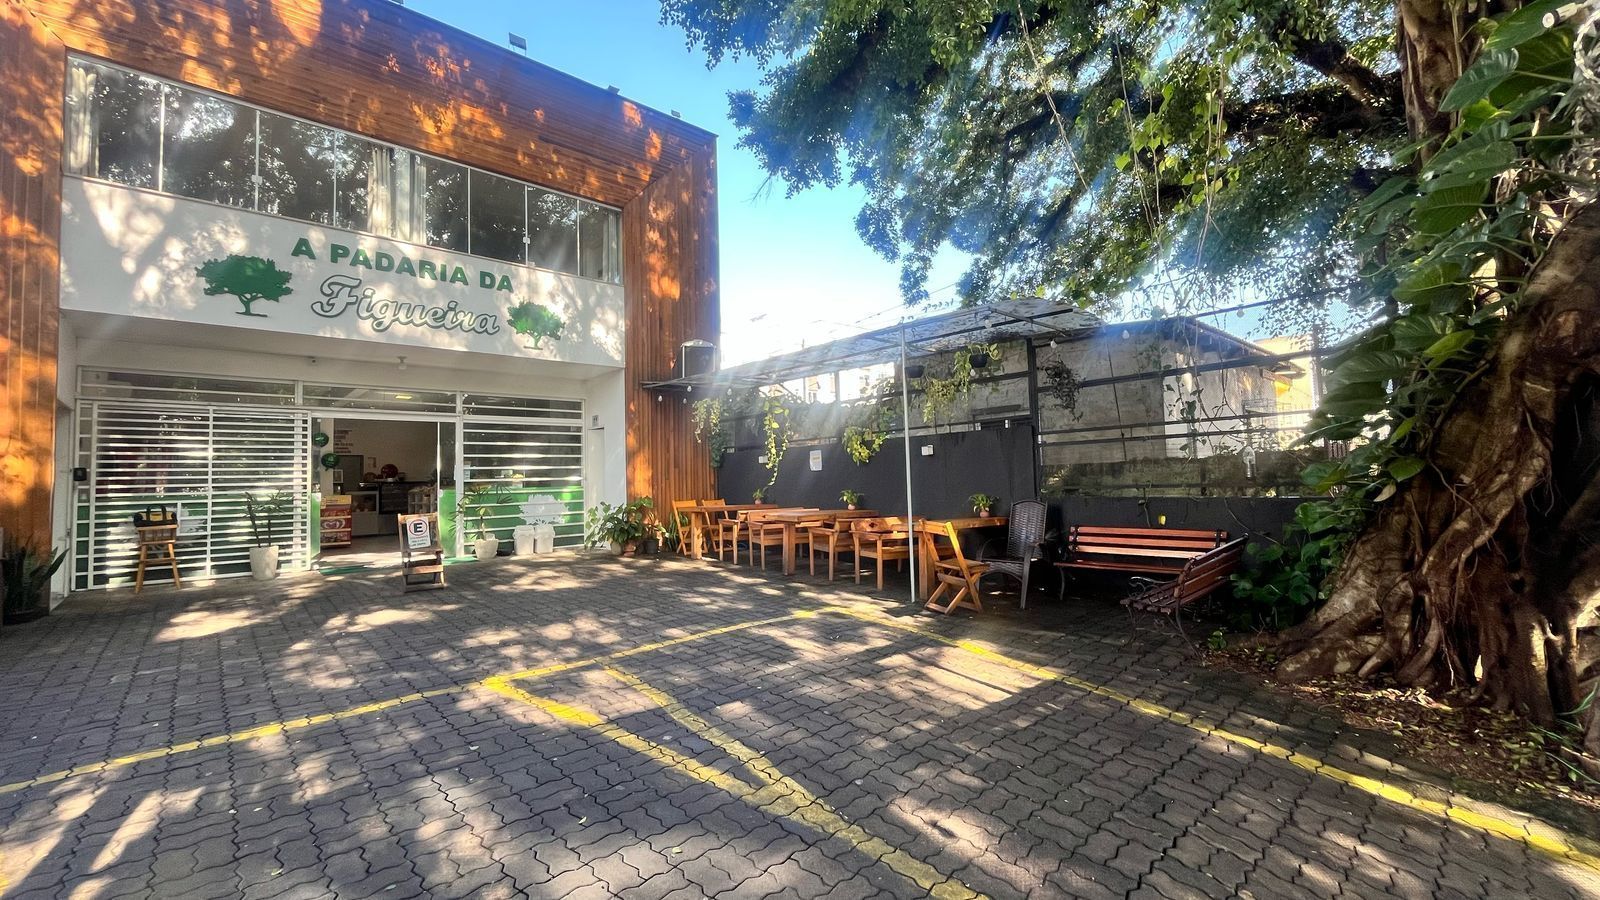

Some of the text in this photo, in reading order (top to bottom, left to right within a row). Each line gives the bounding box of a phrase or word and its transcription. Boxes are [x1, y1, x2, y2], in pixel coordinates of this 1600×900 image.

[292, 238, 513, 292] A PADARIA DA
[311, 274, 500, 334] Figueira
[413, 522, 423, 533] E
